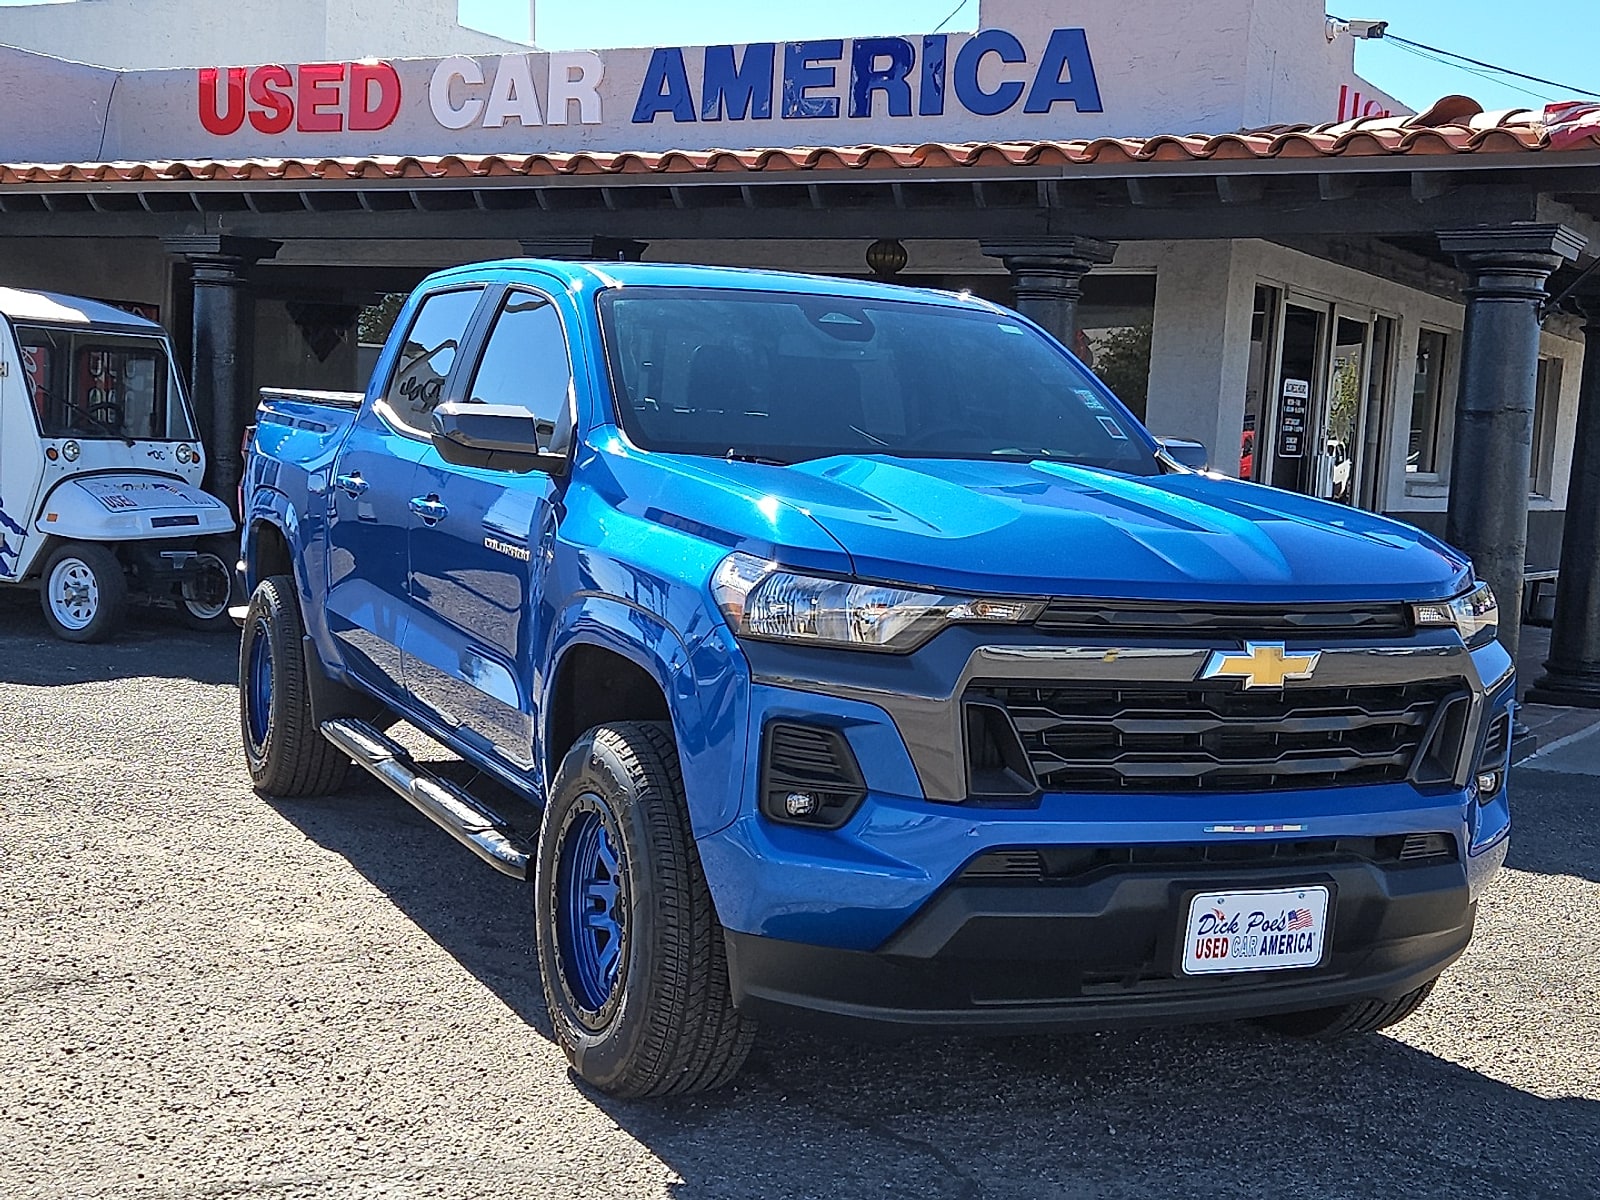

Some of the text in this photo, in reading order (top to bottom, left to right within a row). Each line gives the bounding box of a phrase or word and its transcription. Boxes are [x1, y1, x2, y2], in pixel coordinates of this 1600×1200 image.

[199, 27, 1104, 135] USED CAR AMERICA
[1198, 910, 1287, 935] Dick Poe's
[1195, 932, 1314, 959] USED CAR AMERICA
